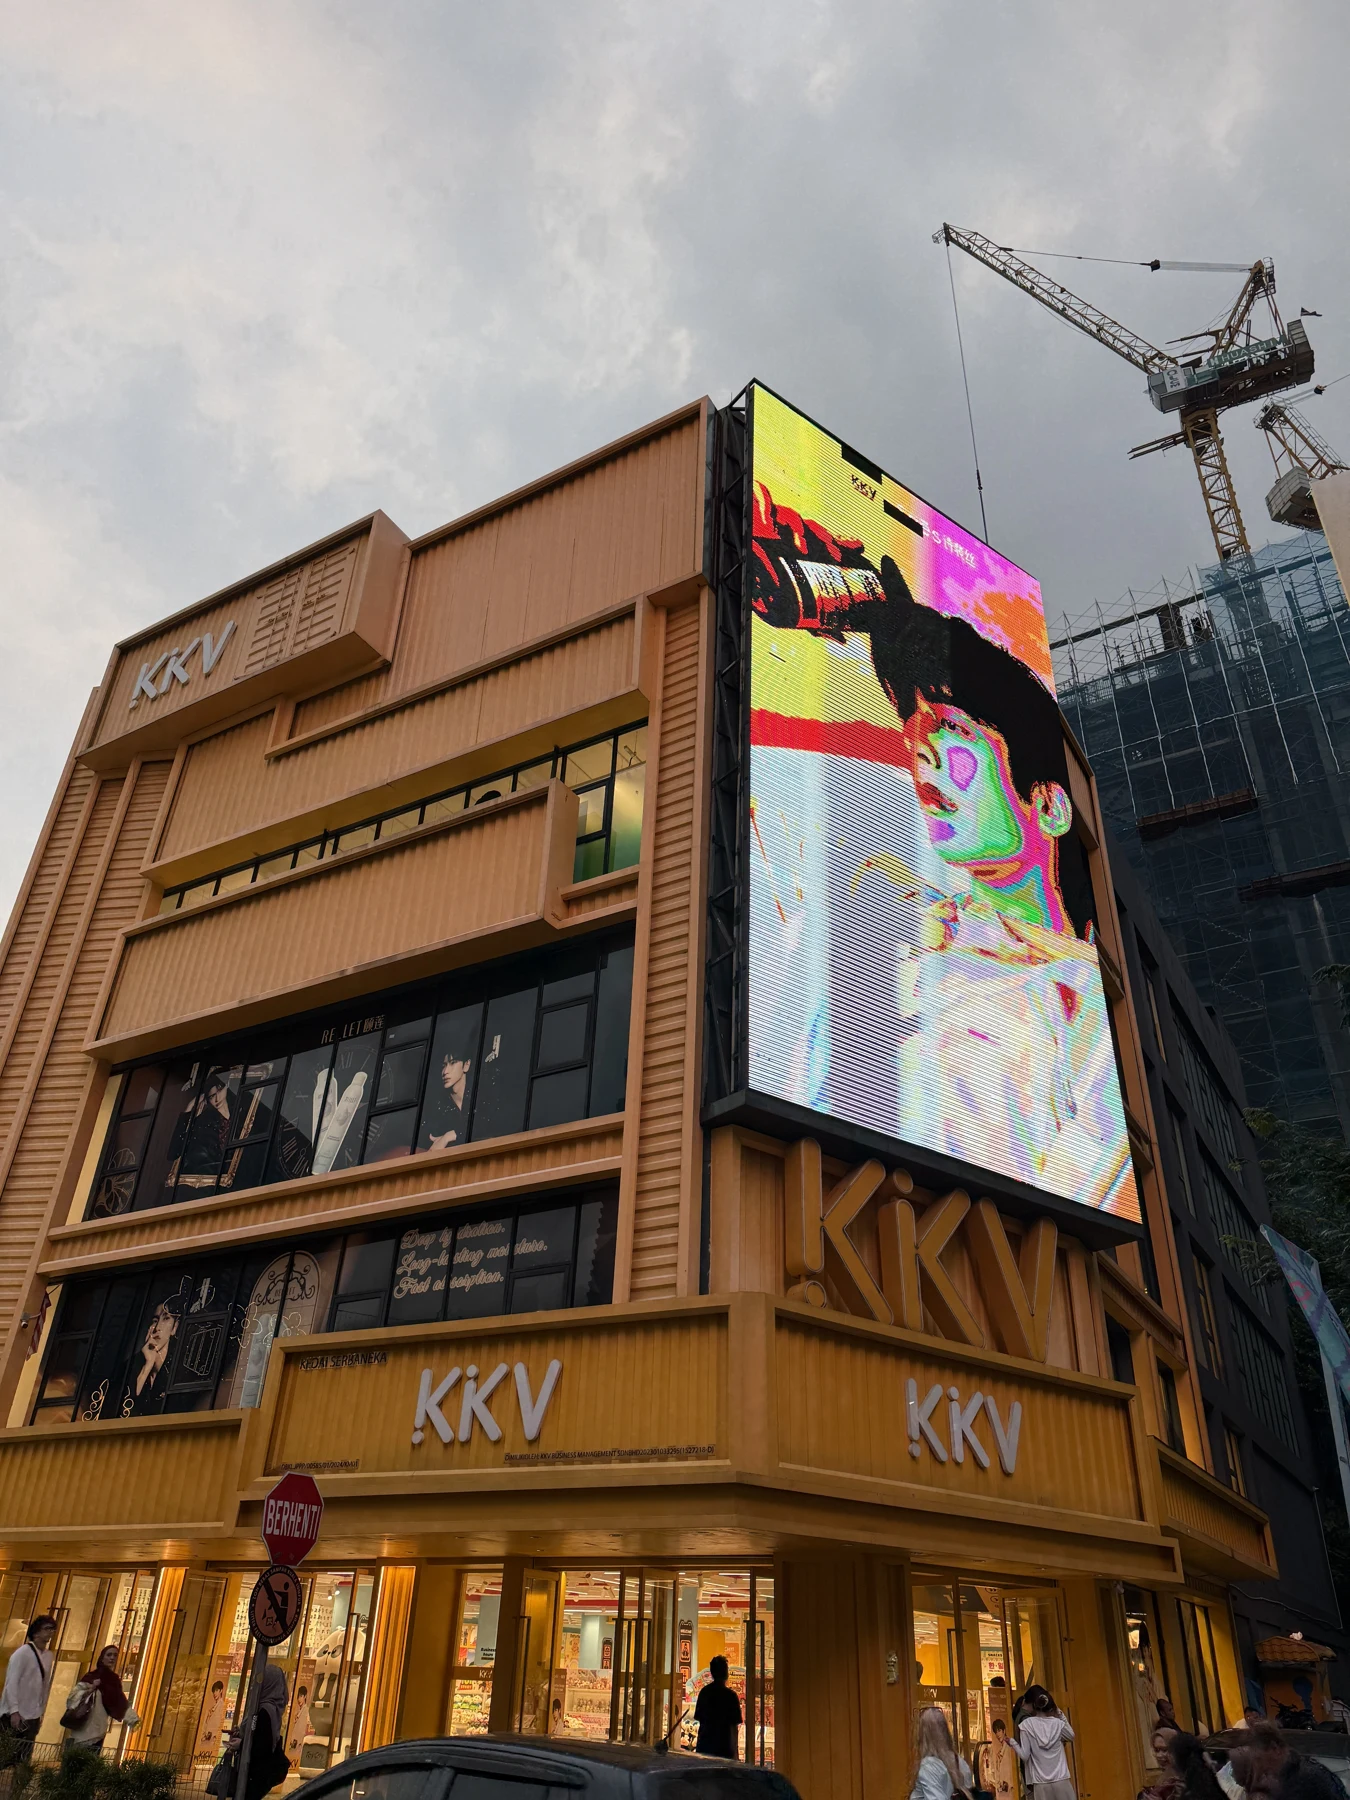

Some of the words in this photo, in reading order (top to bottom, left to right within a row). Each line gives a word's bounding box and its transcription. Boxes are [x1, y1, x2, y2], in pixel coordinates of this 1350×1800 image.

[1221, 340, 1273, 362] HUASHI
[129, 620, 238, 709] KKV
[320, 1020, 362, 1044] RELET
[400, 1228, 437, 1250] Deep
[785, 1137, 1058, 1364] KKV
[393, 1276, 432, 1299] Fast
[299, 1356, 328, 1370] KEDAI
[329, 1352, 387, 1368] SERBANEKA
[411, 1358, 563, 1445] KKV
[905, 1377, 1022, 1475] KKV
[551, 1451, 577, 1459] BUSINESS
[576, 1450, 616, 1458] MANAGEMENT
[265, 1498, 321, 1540] BERHENTI
